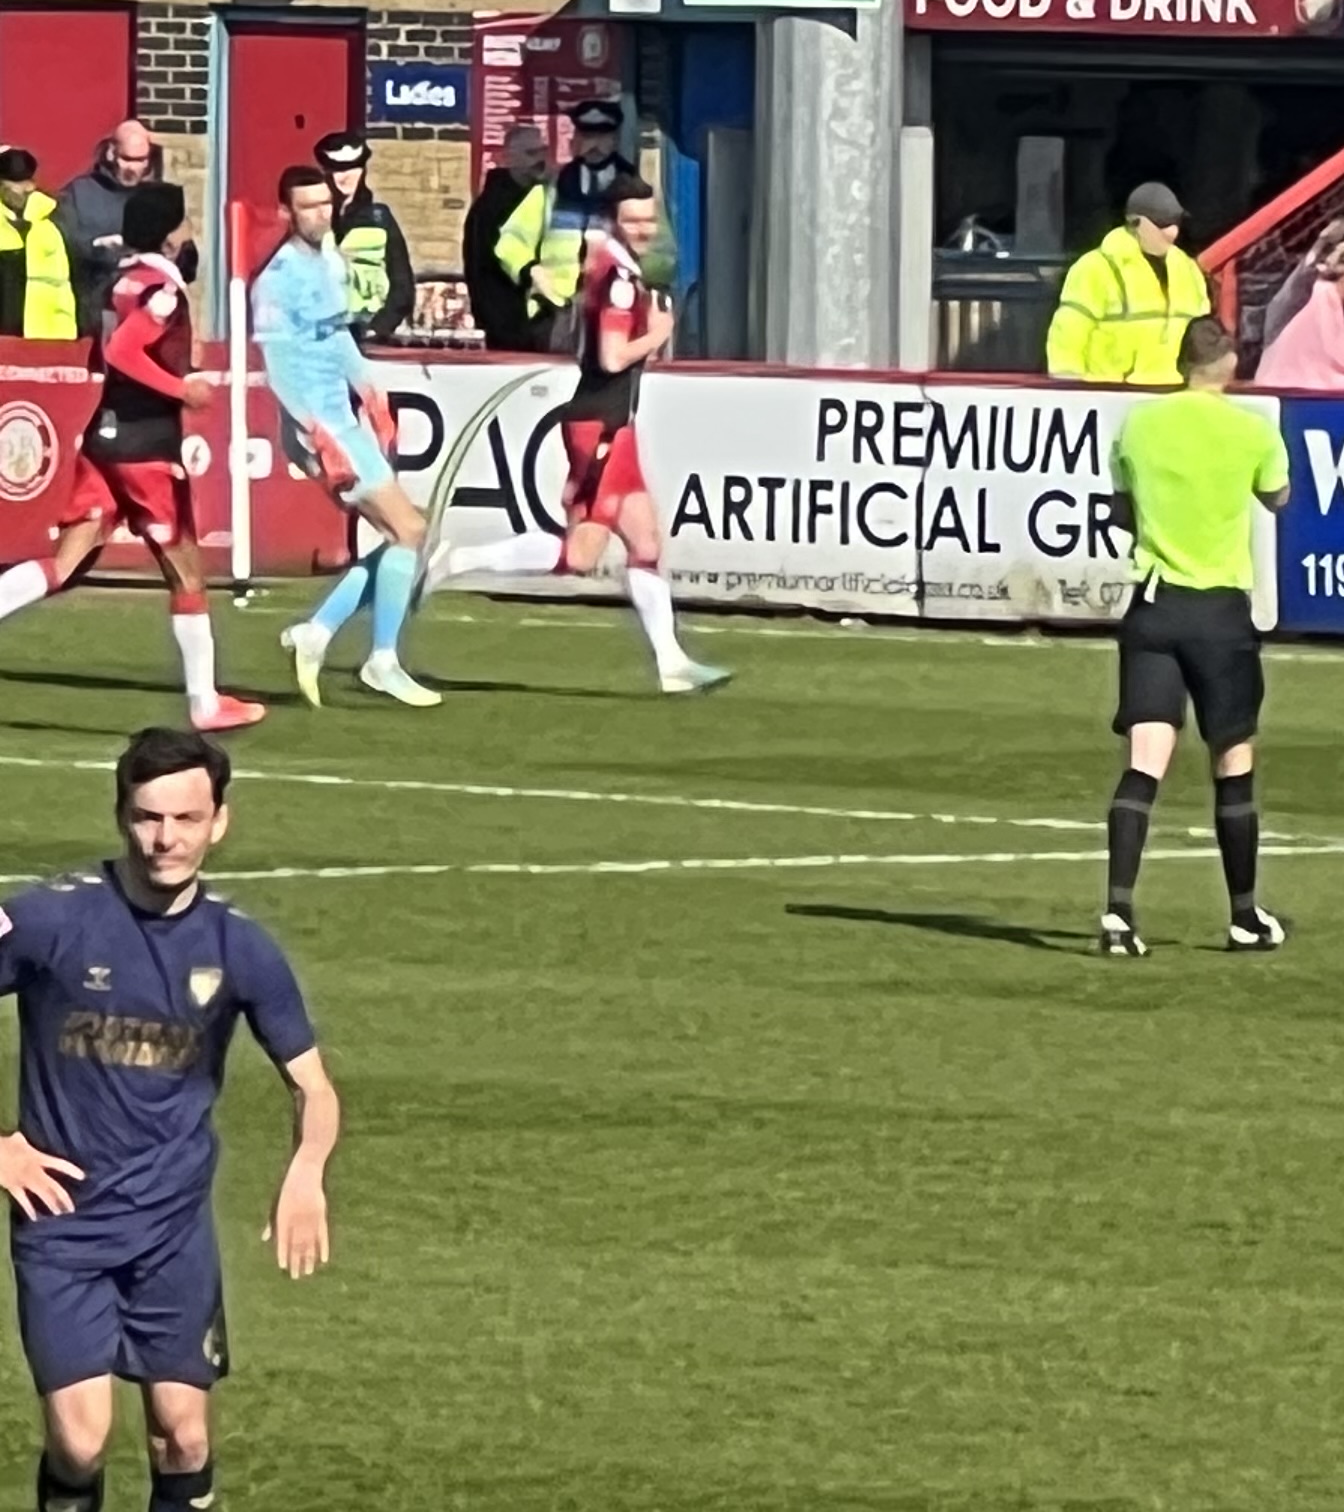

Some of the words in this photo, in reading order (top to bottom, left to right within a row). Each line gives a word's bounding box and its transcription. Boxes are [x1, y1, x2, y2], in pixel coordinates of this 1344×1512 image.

[815, 396, 1100, 477] PREMIUM
[669, 472, 1002, 554] ARTIFICIAL
[1027, 489, 1120, 559] GR
